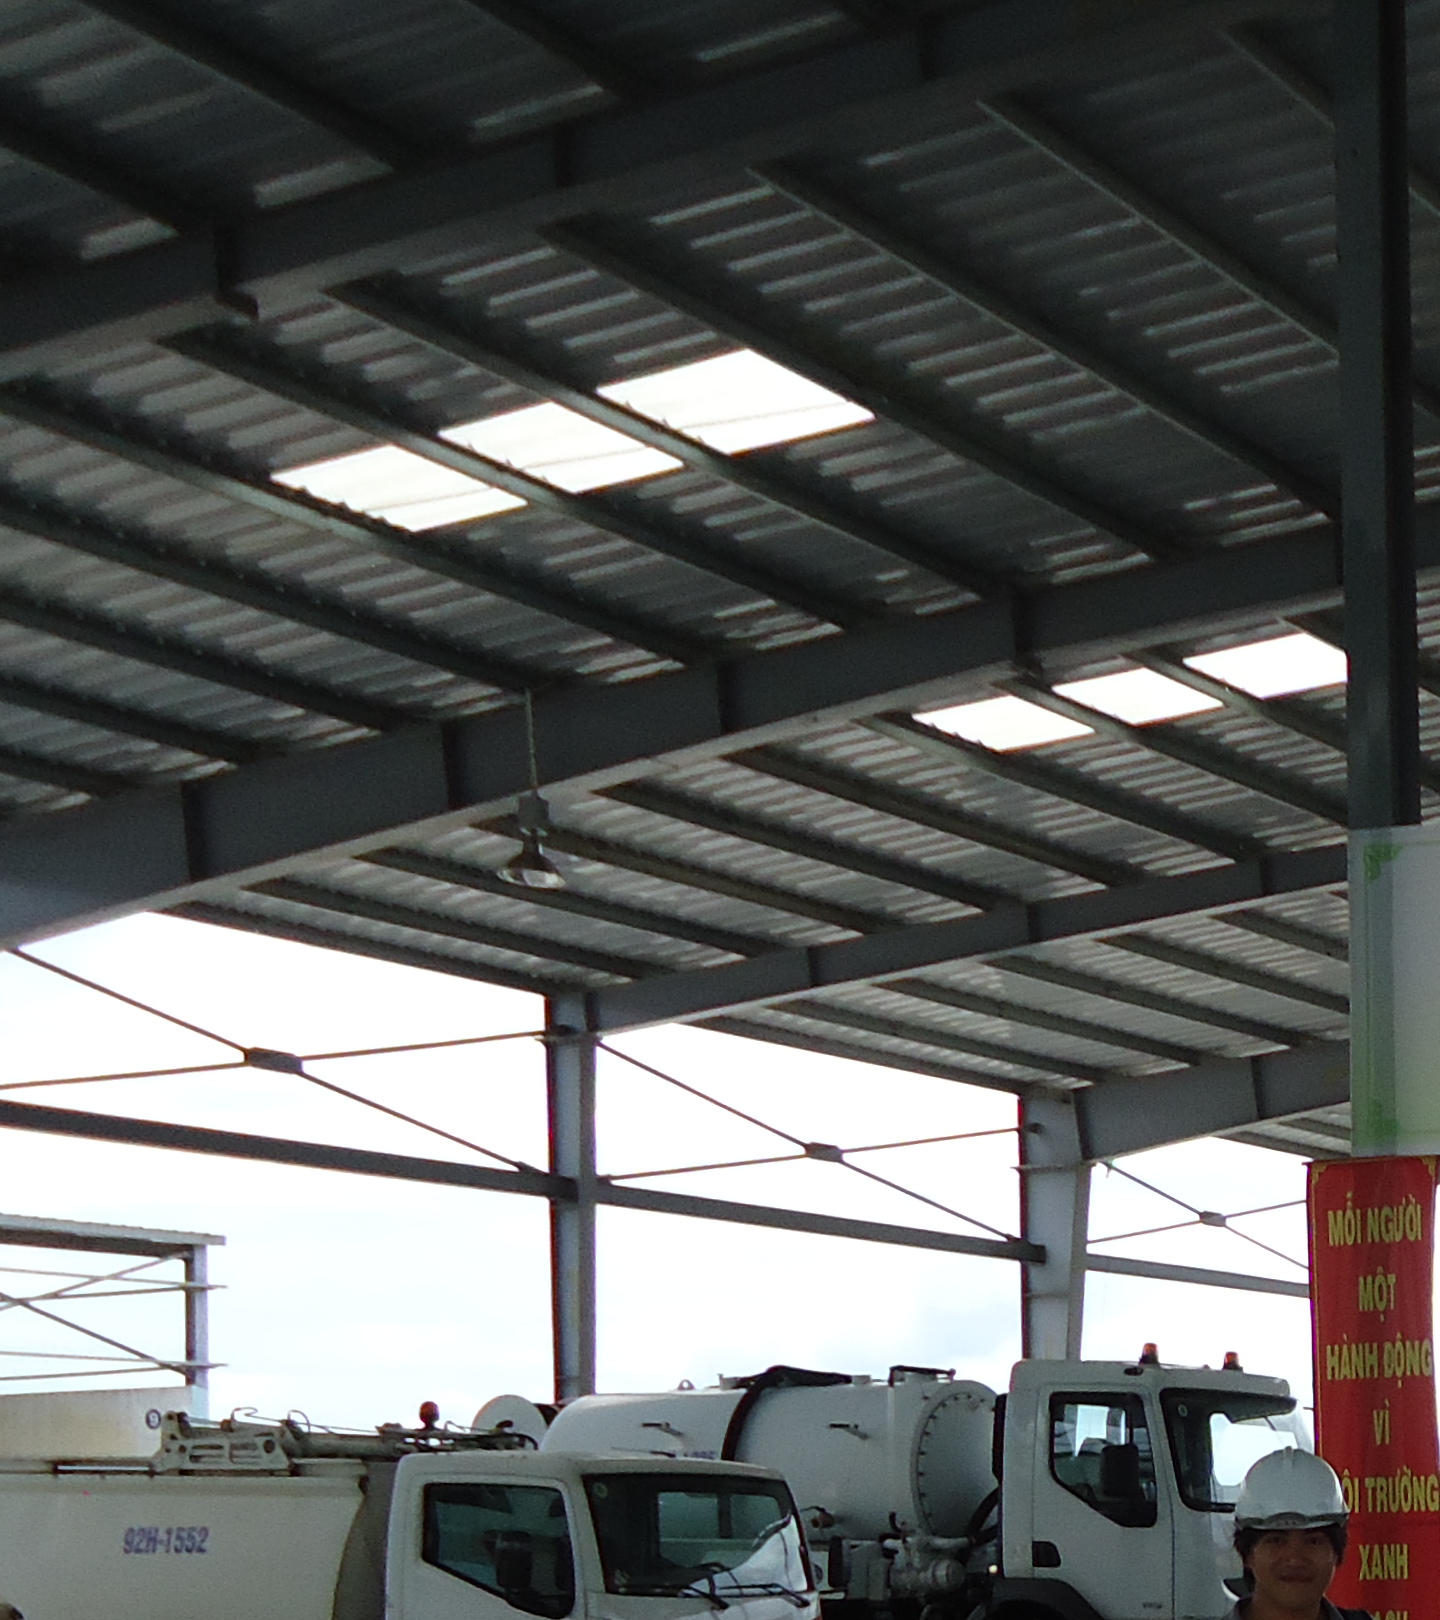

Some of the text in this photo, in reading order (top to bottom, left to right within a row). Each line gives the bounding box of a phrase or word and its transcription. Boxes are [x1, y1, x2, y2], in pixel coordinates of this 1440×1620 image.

[1327, 1191, 1423, 1247] MỖI NGƯỜI
[1358, 1265, 1397, 1323] MỘT
[1326, 1331, 1432, 1389] HÀNH ĐỘNG
[1373, 1398, 1390, 1446] VÌ
[1341, 1466, 1440, 1513] ÔI TRƯỜNG
[123, 1526, 209, 1554] 92H-1552
[1359, 1543, 1409, 1581] XANH
